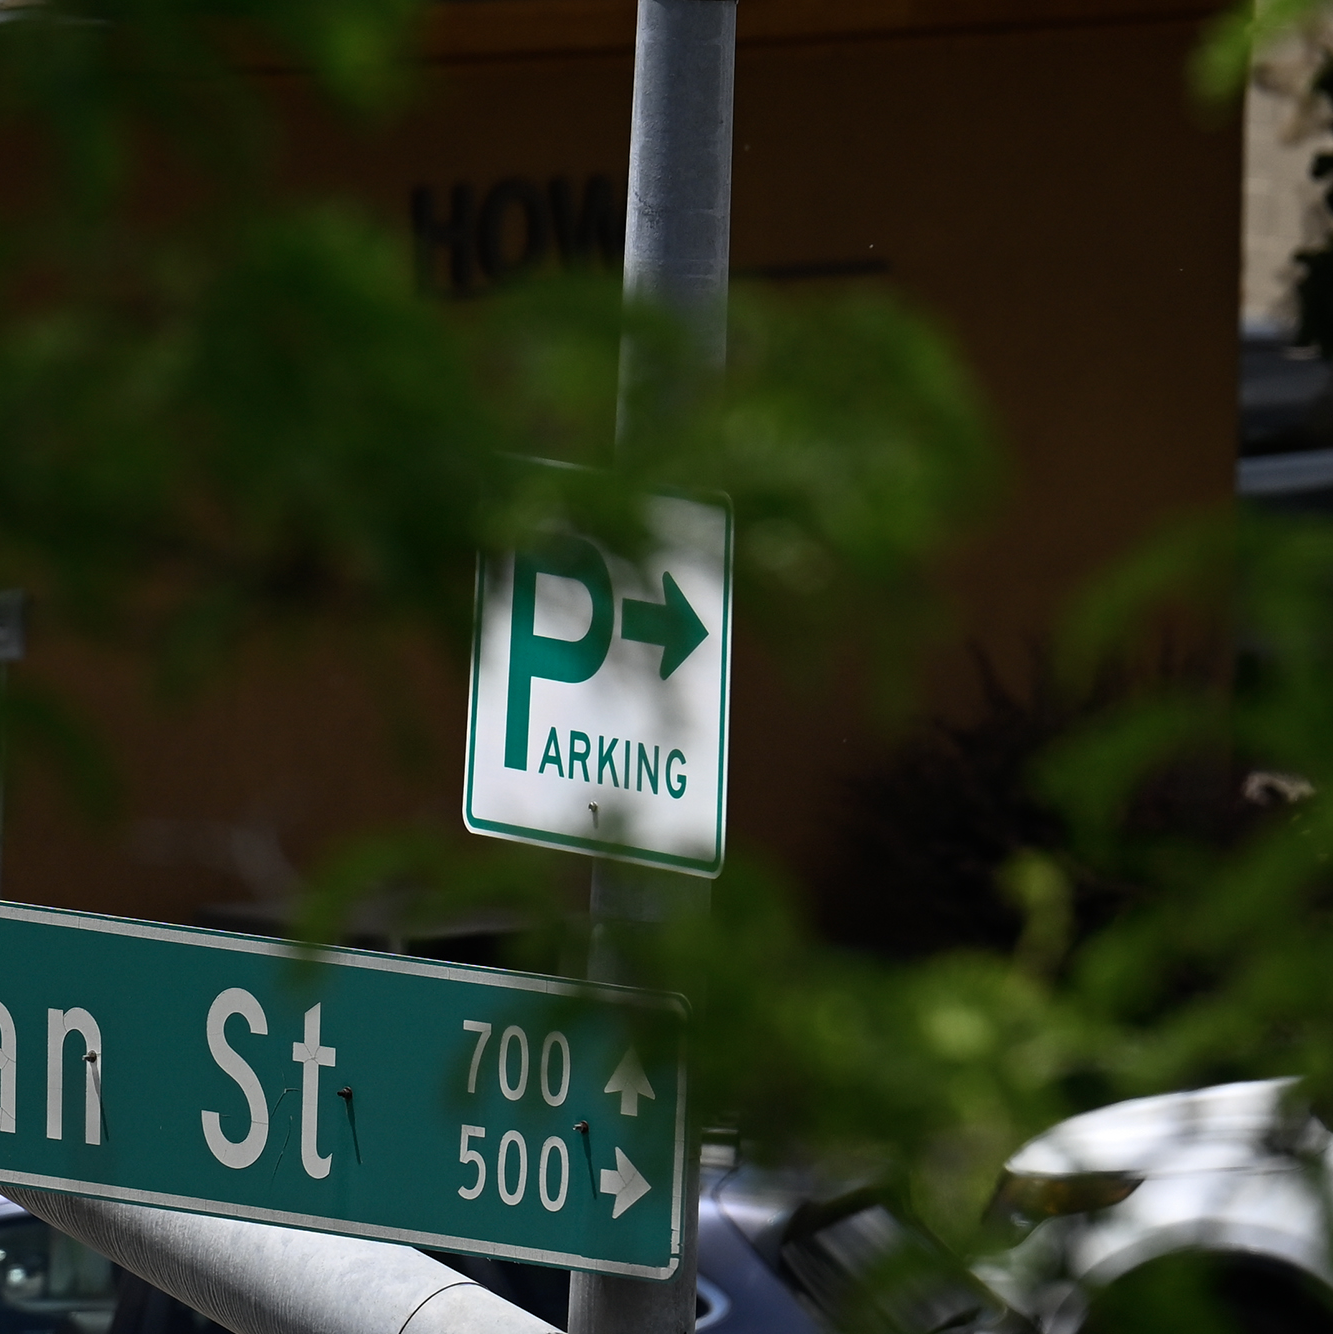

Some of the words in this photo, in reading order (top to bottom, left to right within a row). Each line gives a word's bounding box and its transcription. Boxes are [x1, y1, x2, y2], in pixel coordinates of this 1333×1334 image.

[200, 987, 337, 1180] St
[461, 1018, 572, 1108] 700
[457, 1123, 571, 1213] 500
